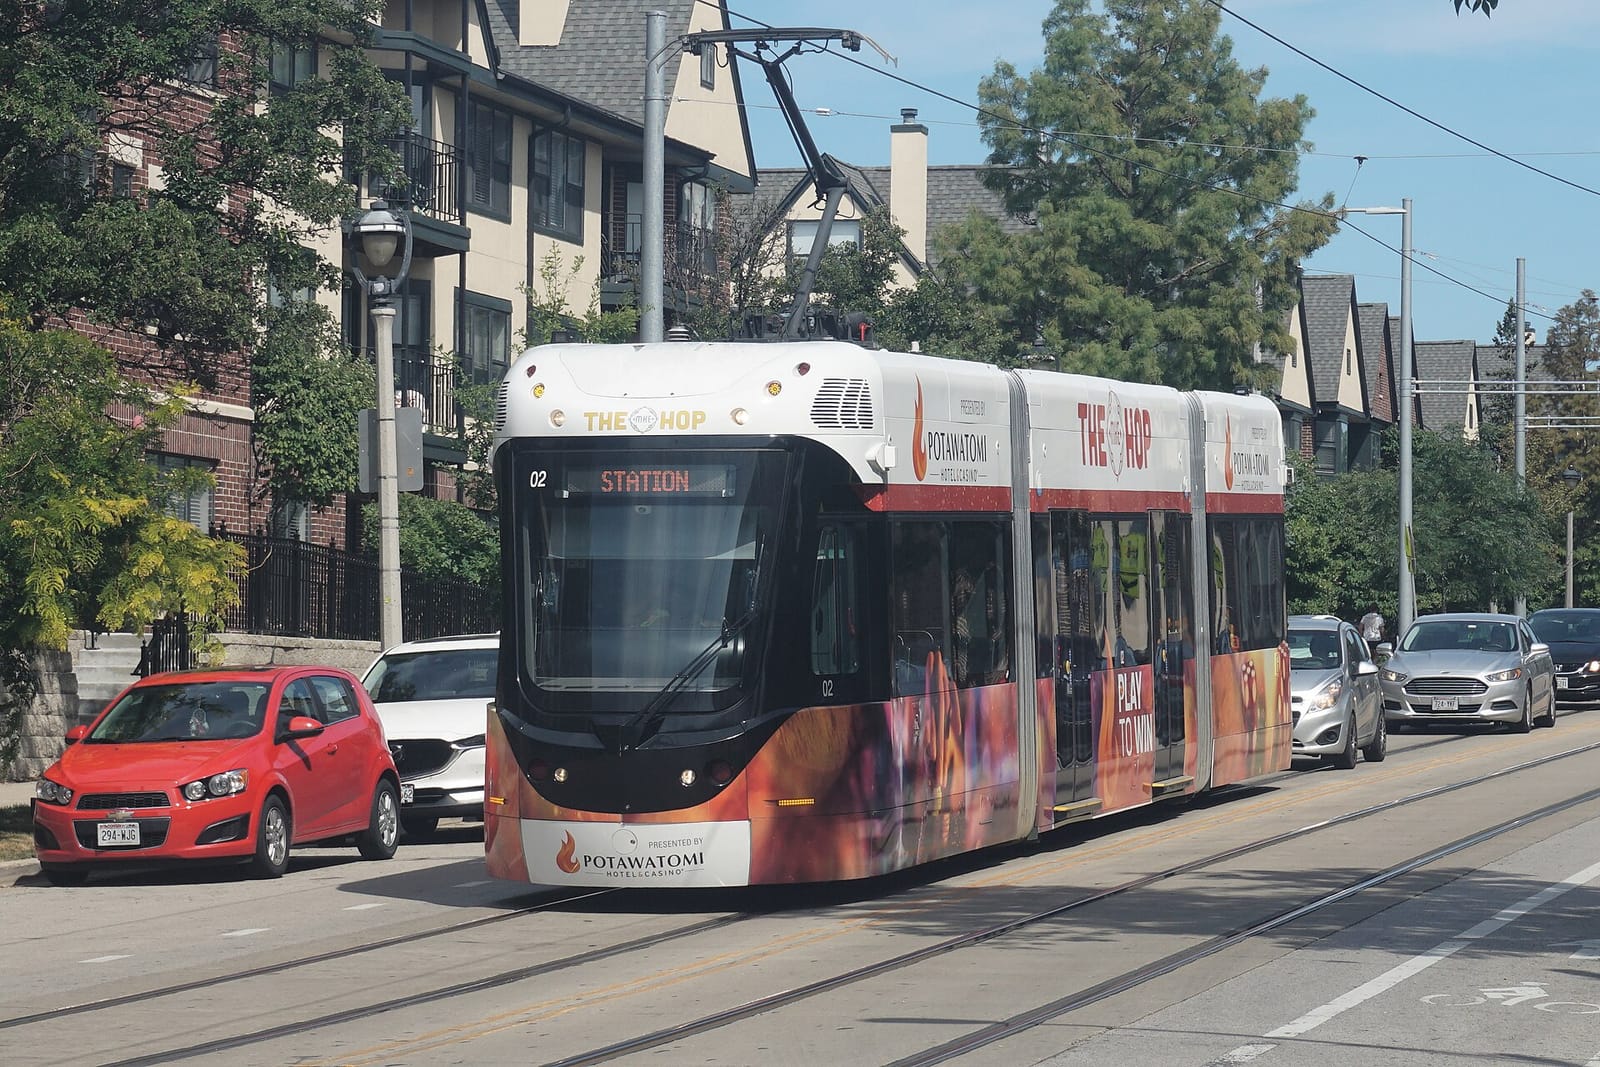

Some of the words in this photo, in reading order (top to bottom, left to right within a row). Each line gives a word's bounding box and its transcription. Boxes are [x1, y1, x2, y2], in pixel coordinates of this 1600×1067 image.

[583, 411, 628, 431] THE
[660, 410, 706, 430] HOP
[1077, 402, 1107, 467] THE
[1124, 407, 1152, 470] HOP
[928, 431, 987, 463] POTAWATOMI
[530, 470, 547, 488] 02
[601, 470, 689, 492] STATION
[822, 679, 834, 697] 02
[1117, 671, 1142, 712] PLAY
[1119, 716, 1133, 757] TO
[1133, 713, 1153, 754] WIN
[101, 829, 136, 842] 294-WJG
[648, 839, 692, 849] PRESENTED
[693, 837, 704, 845] BY
[583, 852, 704, 869] POTAWATOMI
